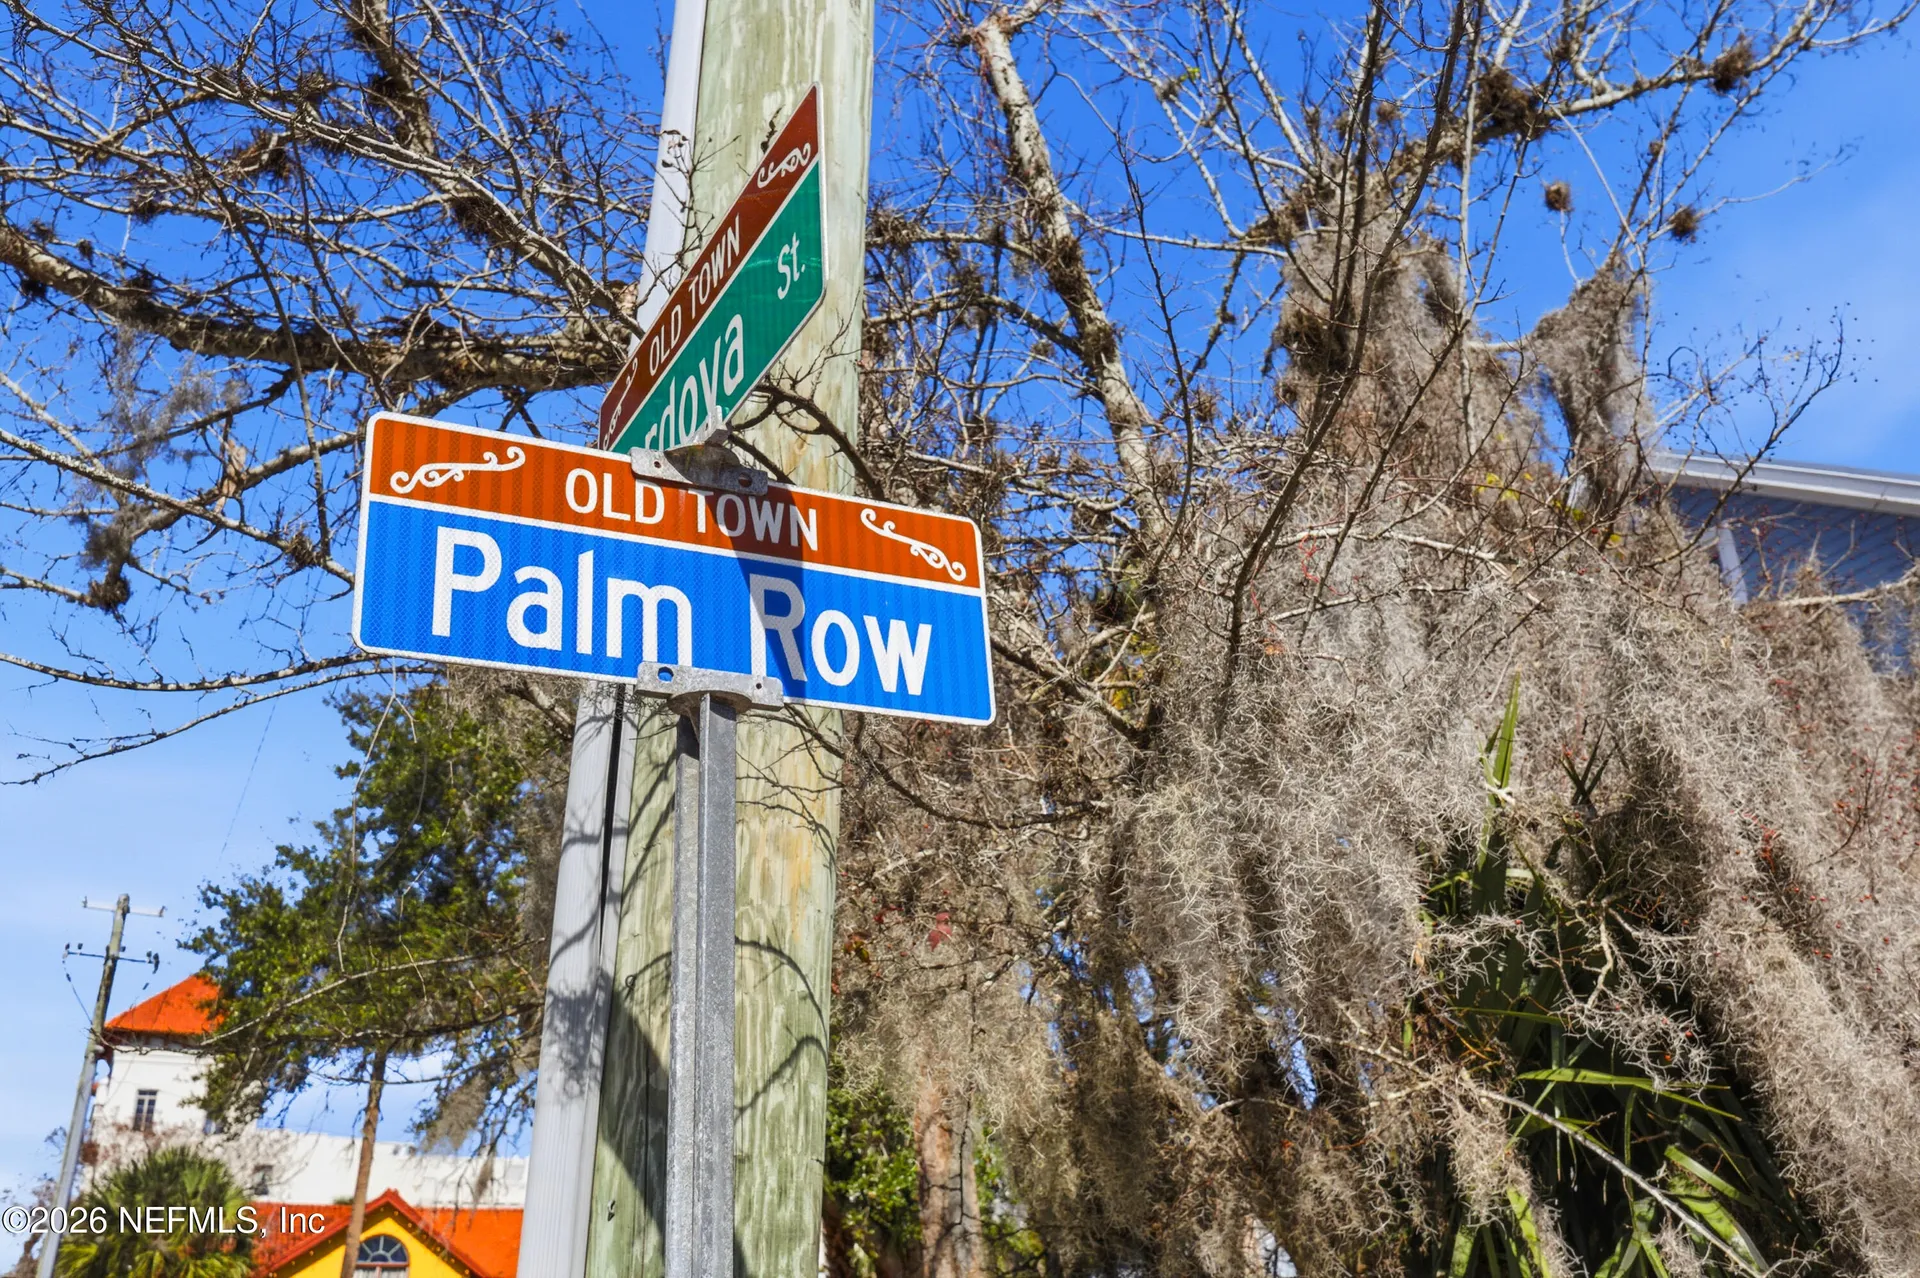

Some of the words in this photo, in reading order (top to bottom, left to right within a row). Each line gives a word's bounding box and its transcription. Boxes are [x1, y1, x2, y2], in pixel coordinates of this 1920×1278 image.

[650, 304, 682, 376] OLD
[688, 213, 741, 319] TOWN
[777, 232, 806, 300] St.
[565, 467, 665, 525] OLD
[688, 488, 818, 551] TOWN
[432, 526, 693, 665] Palm
[750, 573, 932, 696] Row
